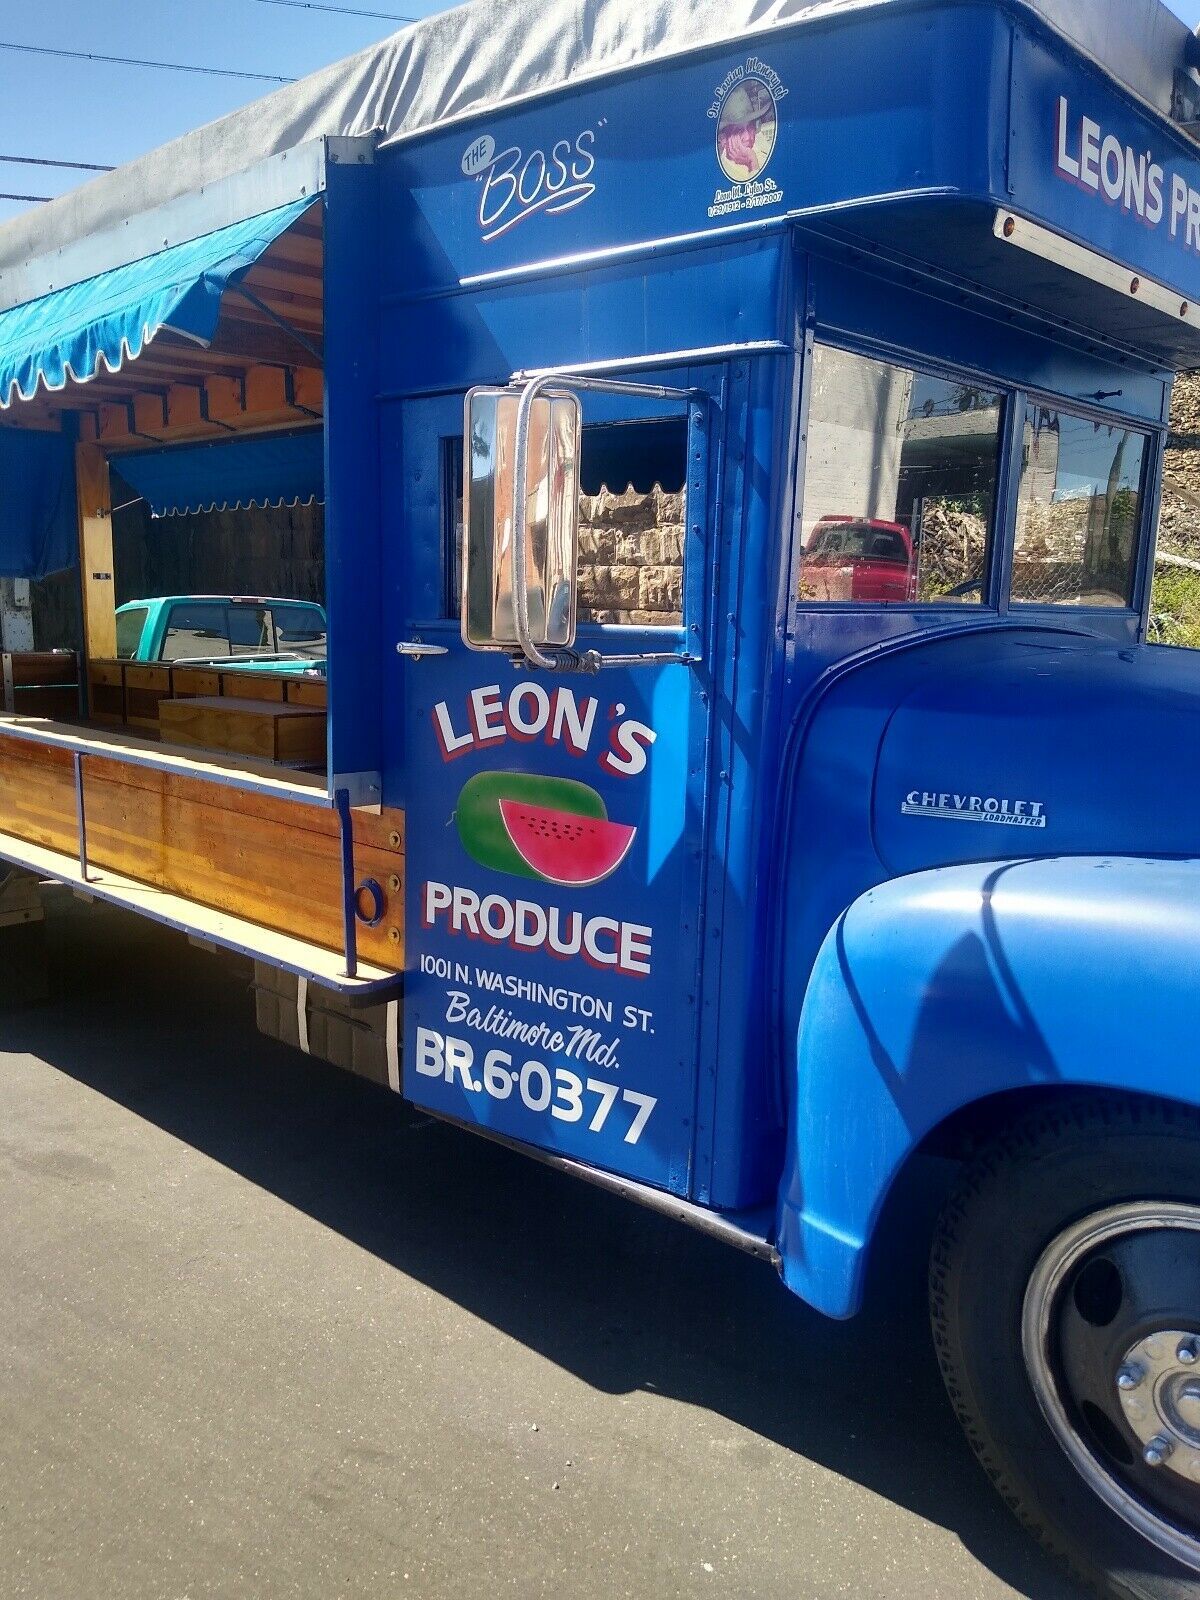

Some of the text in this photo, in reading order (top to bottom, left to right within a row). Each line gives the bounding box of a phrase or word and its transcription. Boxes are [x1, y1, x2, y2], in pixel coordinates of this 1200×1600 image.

[715, 65, 744, 101] Loving
[745, 56, 781, 90] Memory
[464, 139, 488, 172] THE
[1055, 95, 1164, 230] LEON'S
[714, 189, 732, 204] Leon
[432, 681, 657, 776] LEON'S
[906, 790, 1044, 817] CHEVROLET
[983, 812, 1043, 827] LOADMASTER
[423, 880, 653, 977] PRODUCE
[420, 953, 655, 1034] 1001 N. WASHINGTON ST.
[445, 990, 620, 1069] Baltimore Md.
